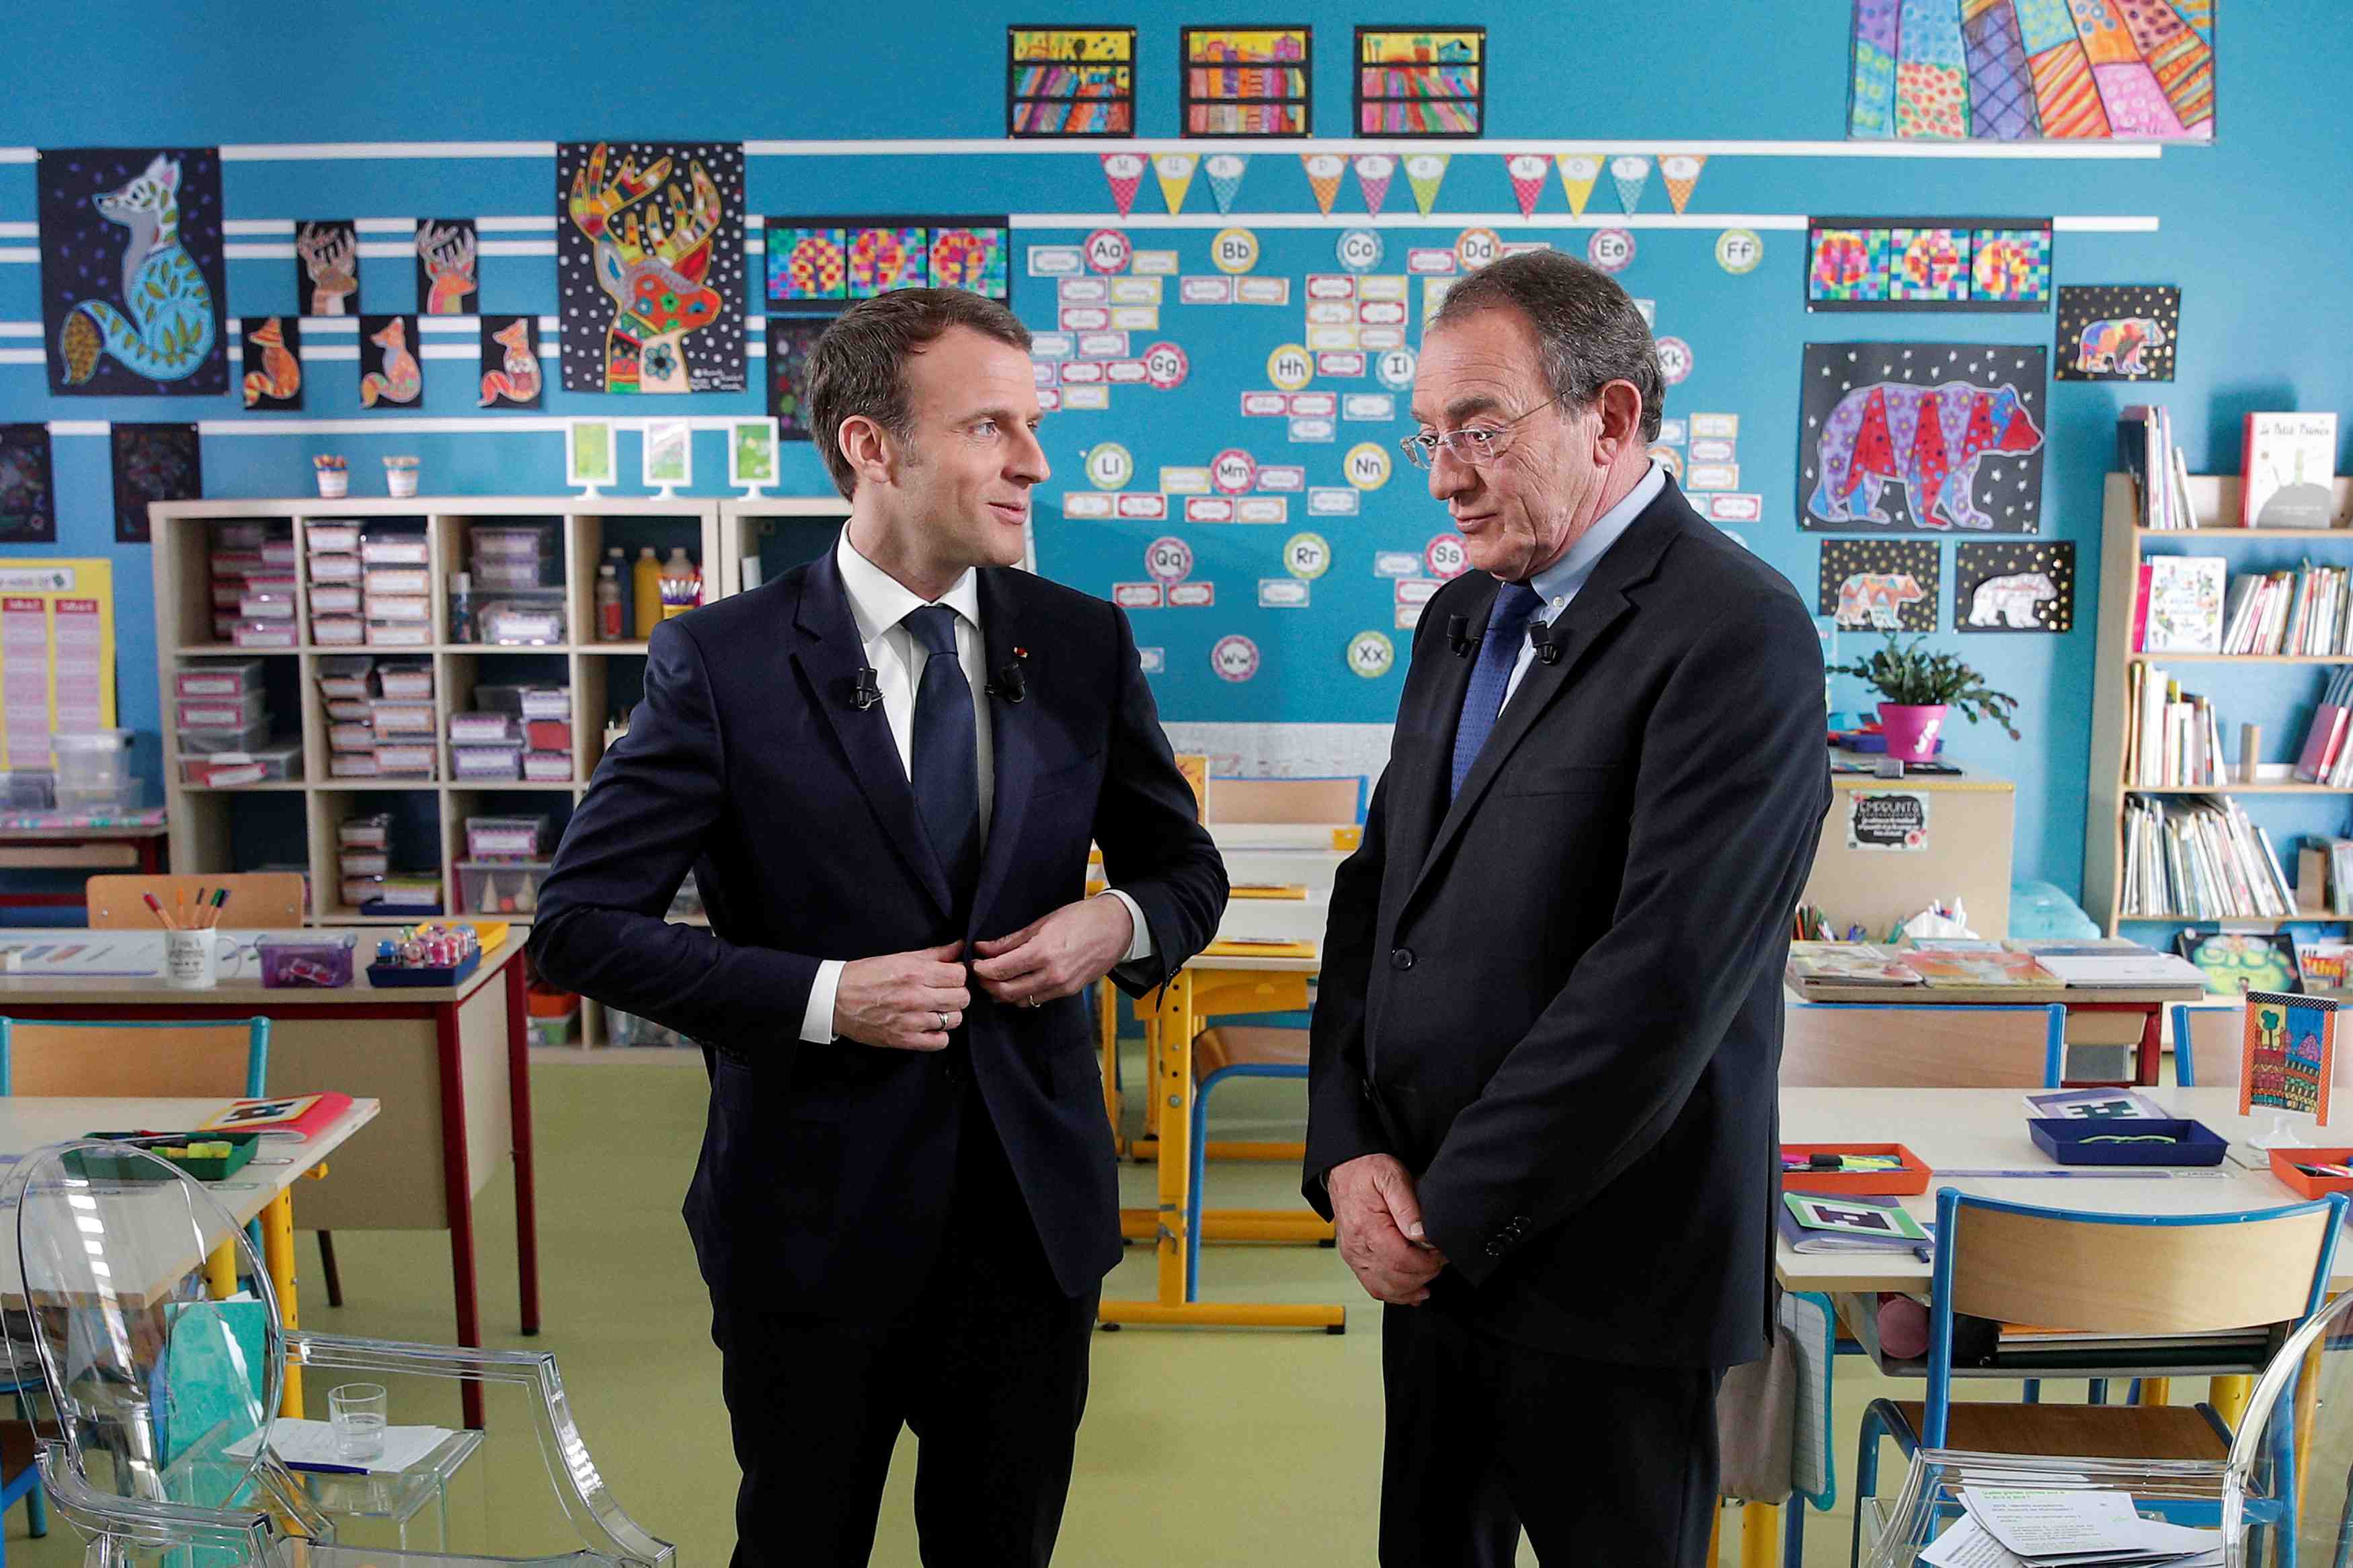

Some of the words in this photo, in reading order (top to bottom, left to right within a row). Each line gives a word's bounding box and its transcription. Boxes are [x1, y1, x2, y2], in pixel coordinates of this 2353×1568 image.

[1094, 241, 1121, 258] Aa
[1223, 242, 1249, 259] Bb
[1347, 241, 1373, 257] Cc
[1466, 241, 1490, 259] Dd
[1600, 241, 1625, 257] Ee
[1727, 243, 1752, 259] Ff
[1151, 355, 1176, 377] Gg
[1279, 359, 1305, 376] Hh
[1391, 357, 1407, 374] Ii
[1103, 457, 1119, 474] Ll
[1220, 462, 1248, 478] Mm
[1357, 458, 1381, 474] Nn
[1156, 551, 1183, 569] Qq
[1297, 547, 1318, 563] Rr
[1435, 547, 1460, 563] Ss
[1222, 650, 1248, 665] Ww
[1359, 647, 1384, 663] Xx
